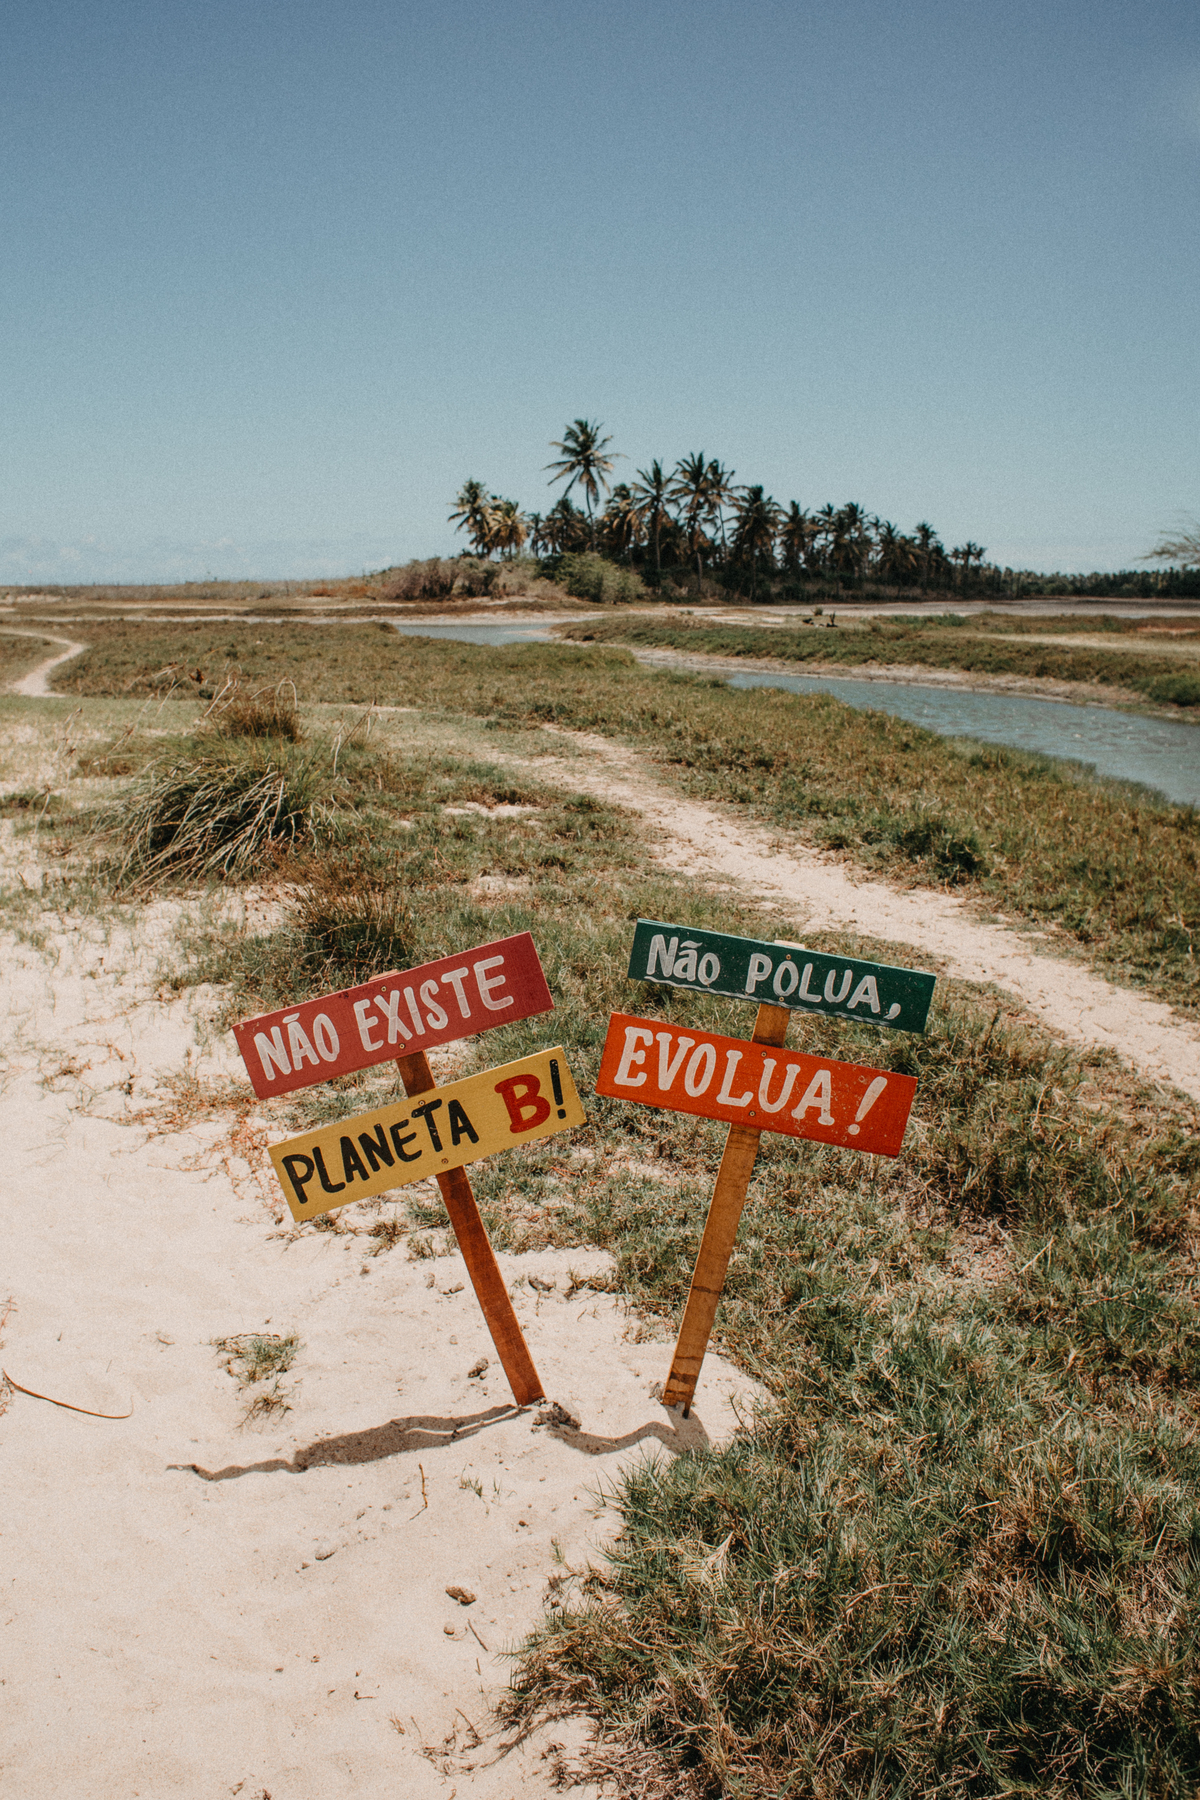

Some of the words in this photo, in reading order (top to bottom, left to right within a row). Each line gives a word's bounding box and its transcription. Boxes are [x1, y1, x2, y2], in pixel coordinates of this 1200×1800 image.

[253, 1012, 340, 1081] NÃO
[353, 955, 514, 1052] EXISTE
[646, 934, 721, 986] Não
[745, 953, 902, 1020] POLUA,
[281, 1099, 480, 1205] PLANETA
[494, 1059, 567, 1134] B!
